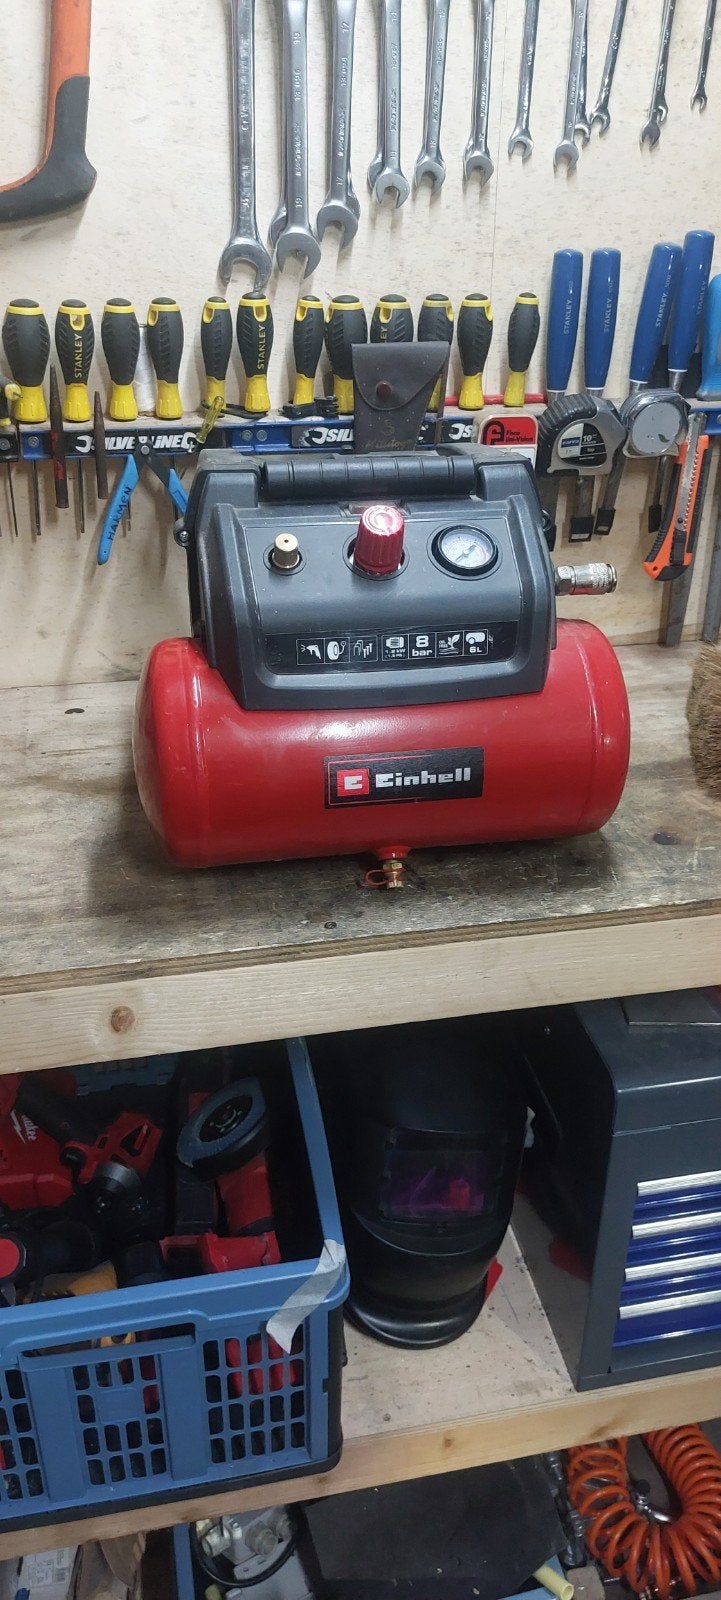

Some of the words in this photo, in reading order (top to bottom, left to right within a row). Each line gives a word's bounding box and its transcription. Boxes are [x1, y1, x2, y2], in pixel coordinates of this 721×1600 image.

[563, 298, 572, 335] STANLEY
[603, 298, 612, 334] STANLEY
[655, 292, 668, 328] STANLEY
[74, 333, 83, 379] STANLEY
[257, 324, 265, 369] STANLEY
[583, 434, 592, 442] 10
[412, 648, 433, 657] bar
[415, 635, 429, 648] 8
[375, 767, 471, 788] Einhell
